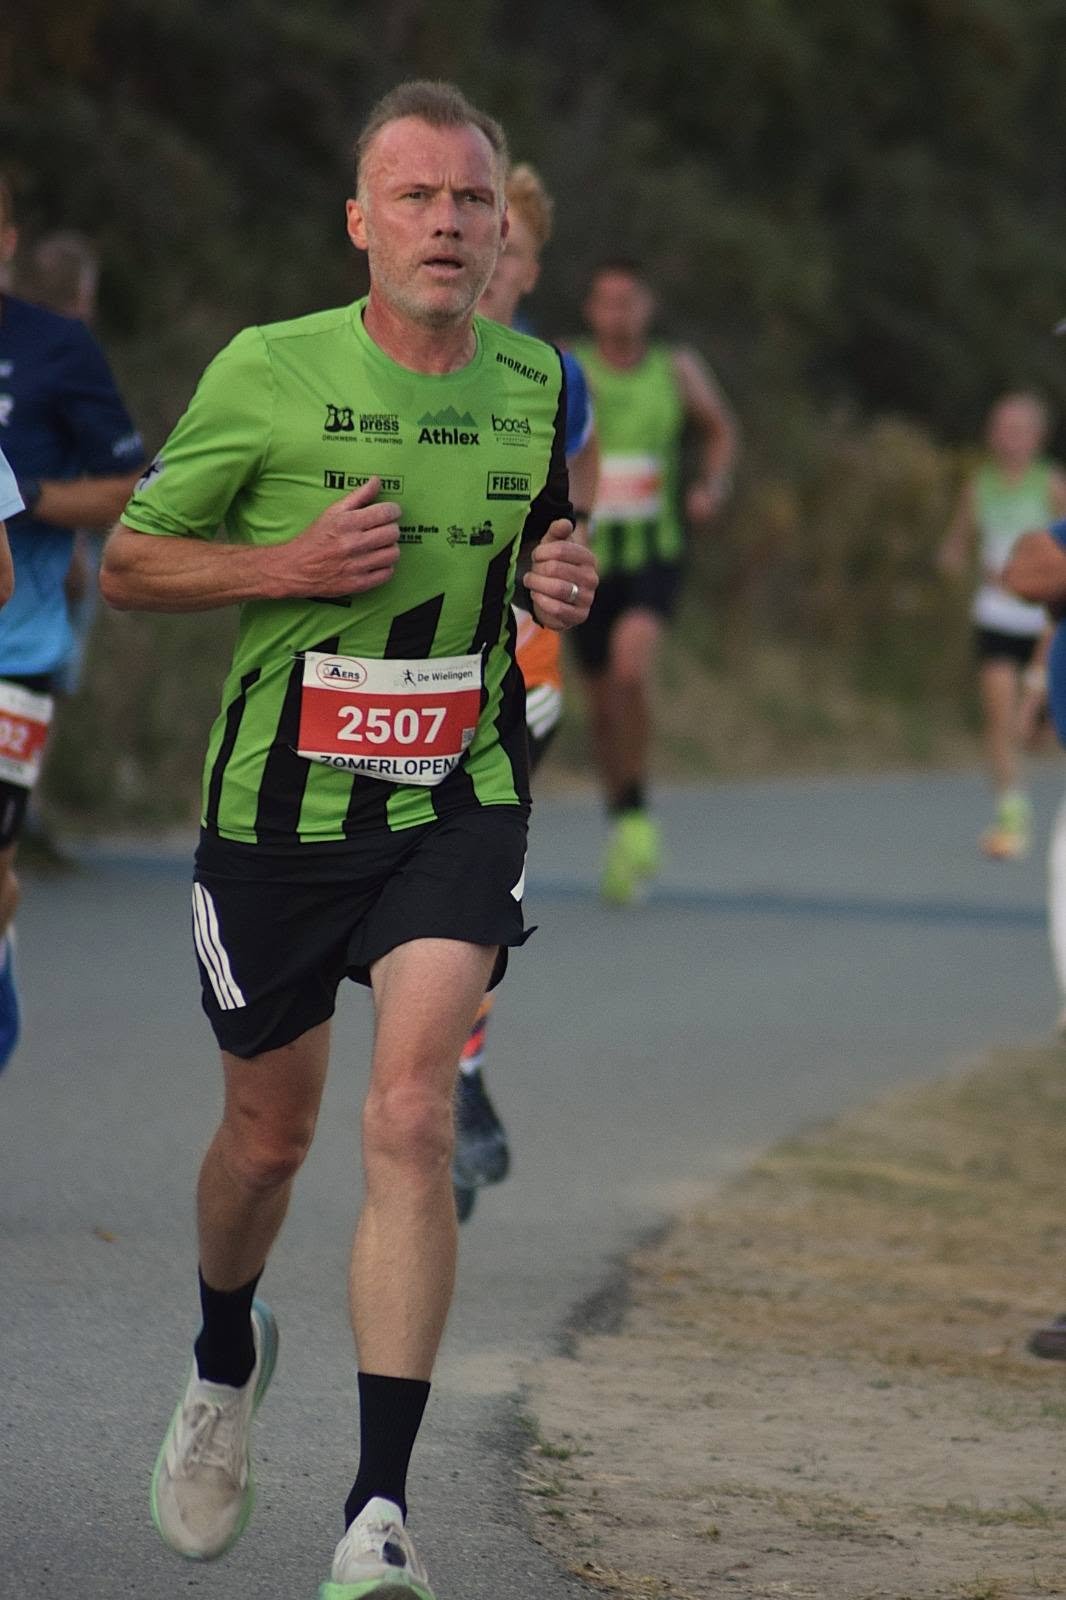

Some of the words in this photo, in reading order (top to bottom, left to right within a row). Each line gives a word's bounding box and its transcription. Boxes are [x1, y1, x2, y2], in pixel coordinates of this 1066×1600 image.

[496, 352, 548, 387] BIORACER
[360, 420, 400, 433] press
[418, 428, 479, 445] Athlex
[326, 472, 344, 488] IT
[417, 673, 430, 682] De
[432, 670, 473, 681] Wielingen
[337, 705, 447, 745] 2507
